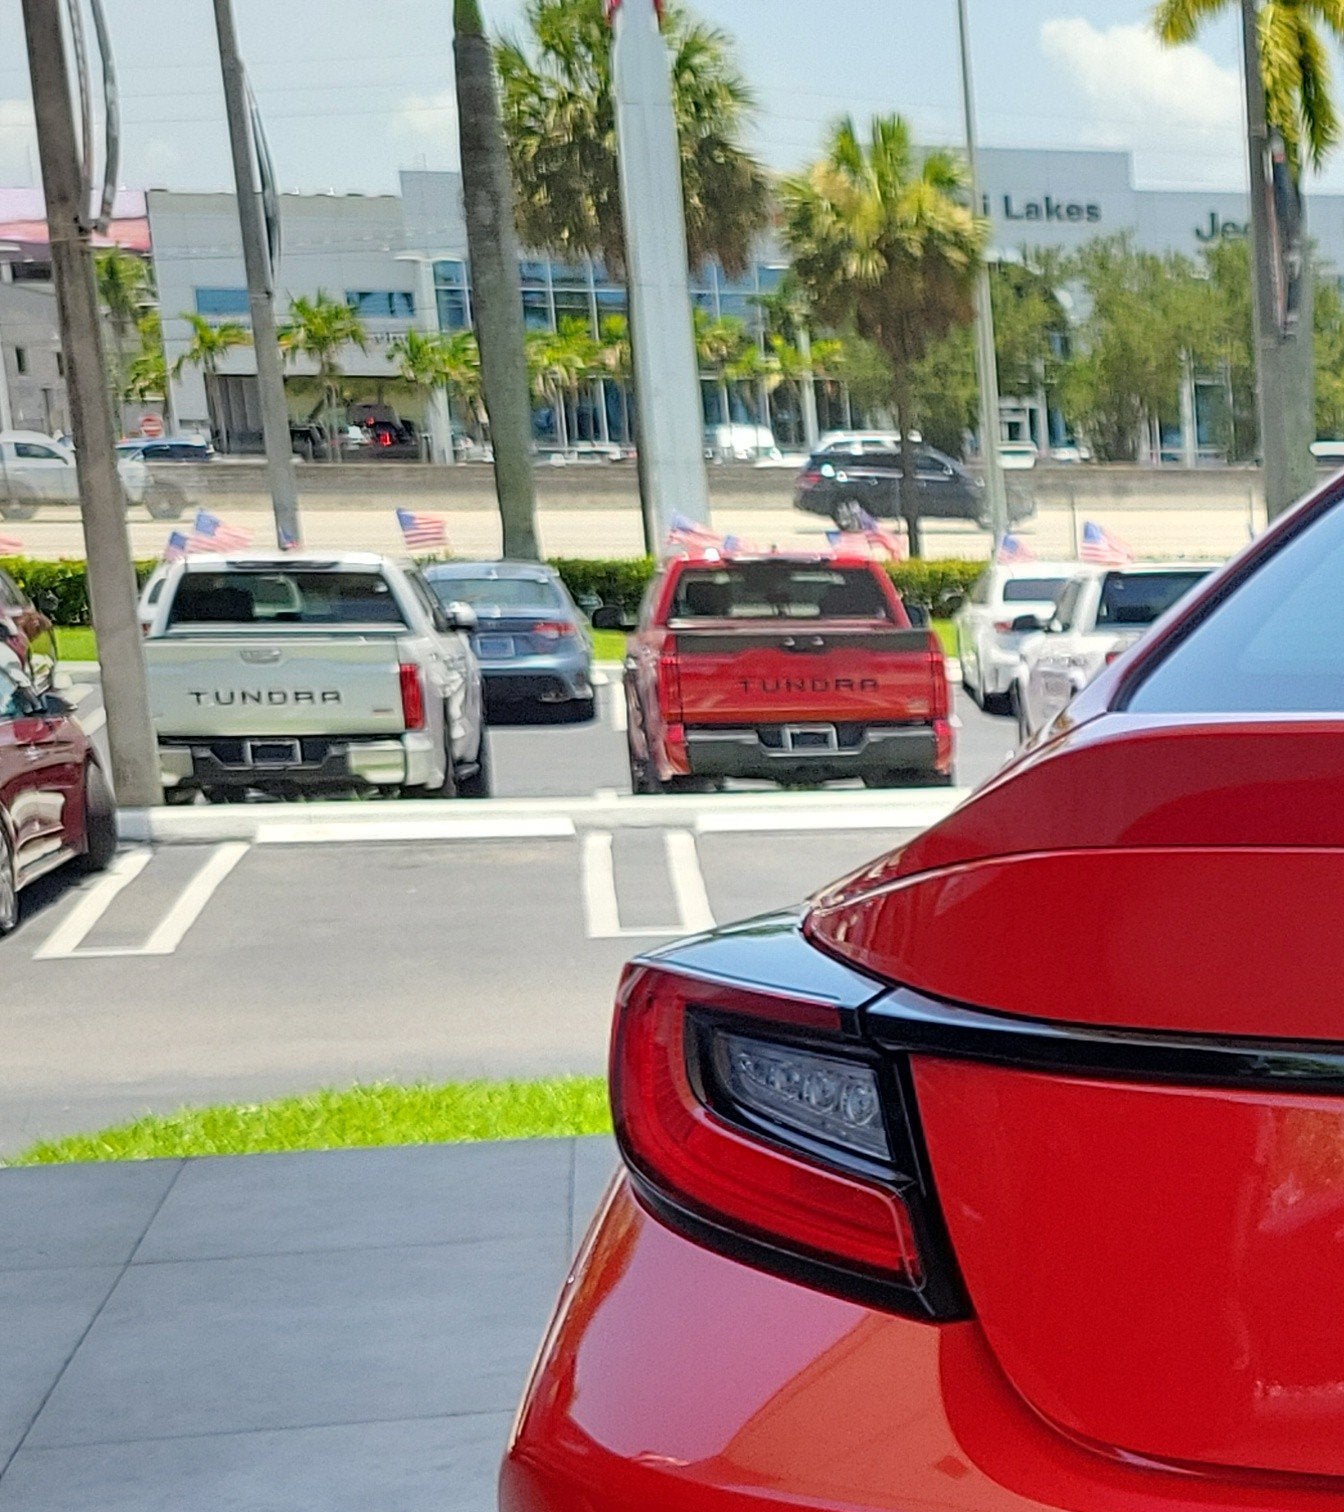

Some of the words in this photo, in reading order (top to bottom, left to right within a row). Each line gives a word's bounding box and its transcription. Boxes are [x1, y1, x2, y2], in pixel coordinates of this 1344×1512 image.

[1004, 194, 1102, 222] Lakes
[738, 678, 879, 693] TUNDRA
[188, 691, 341, 706] TUNDRA
